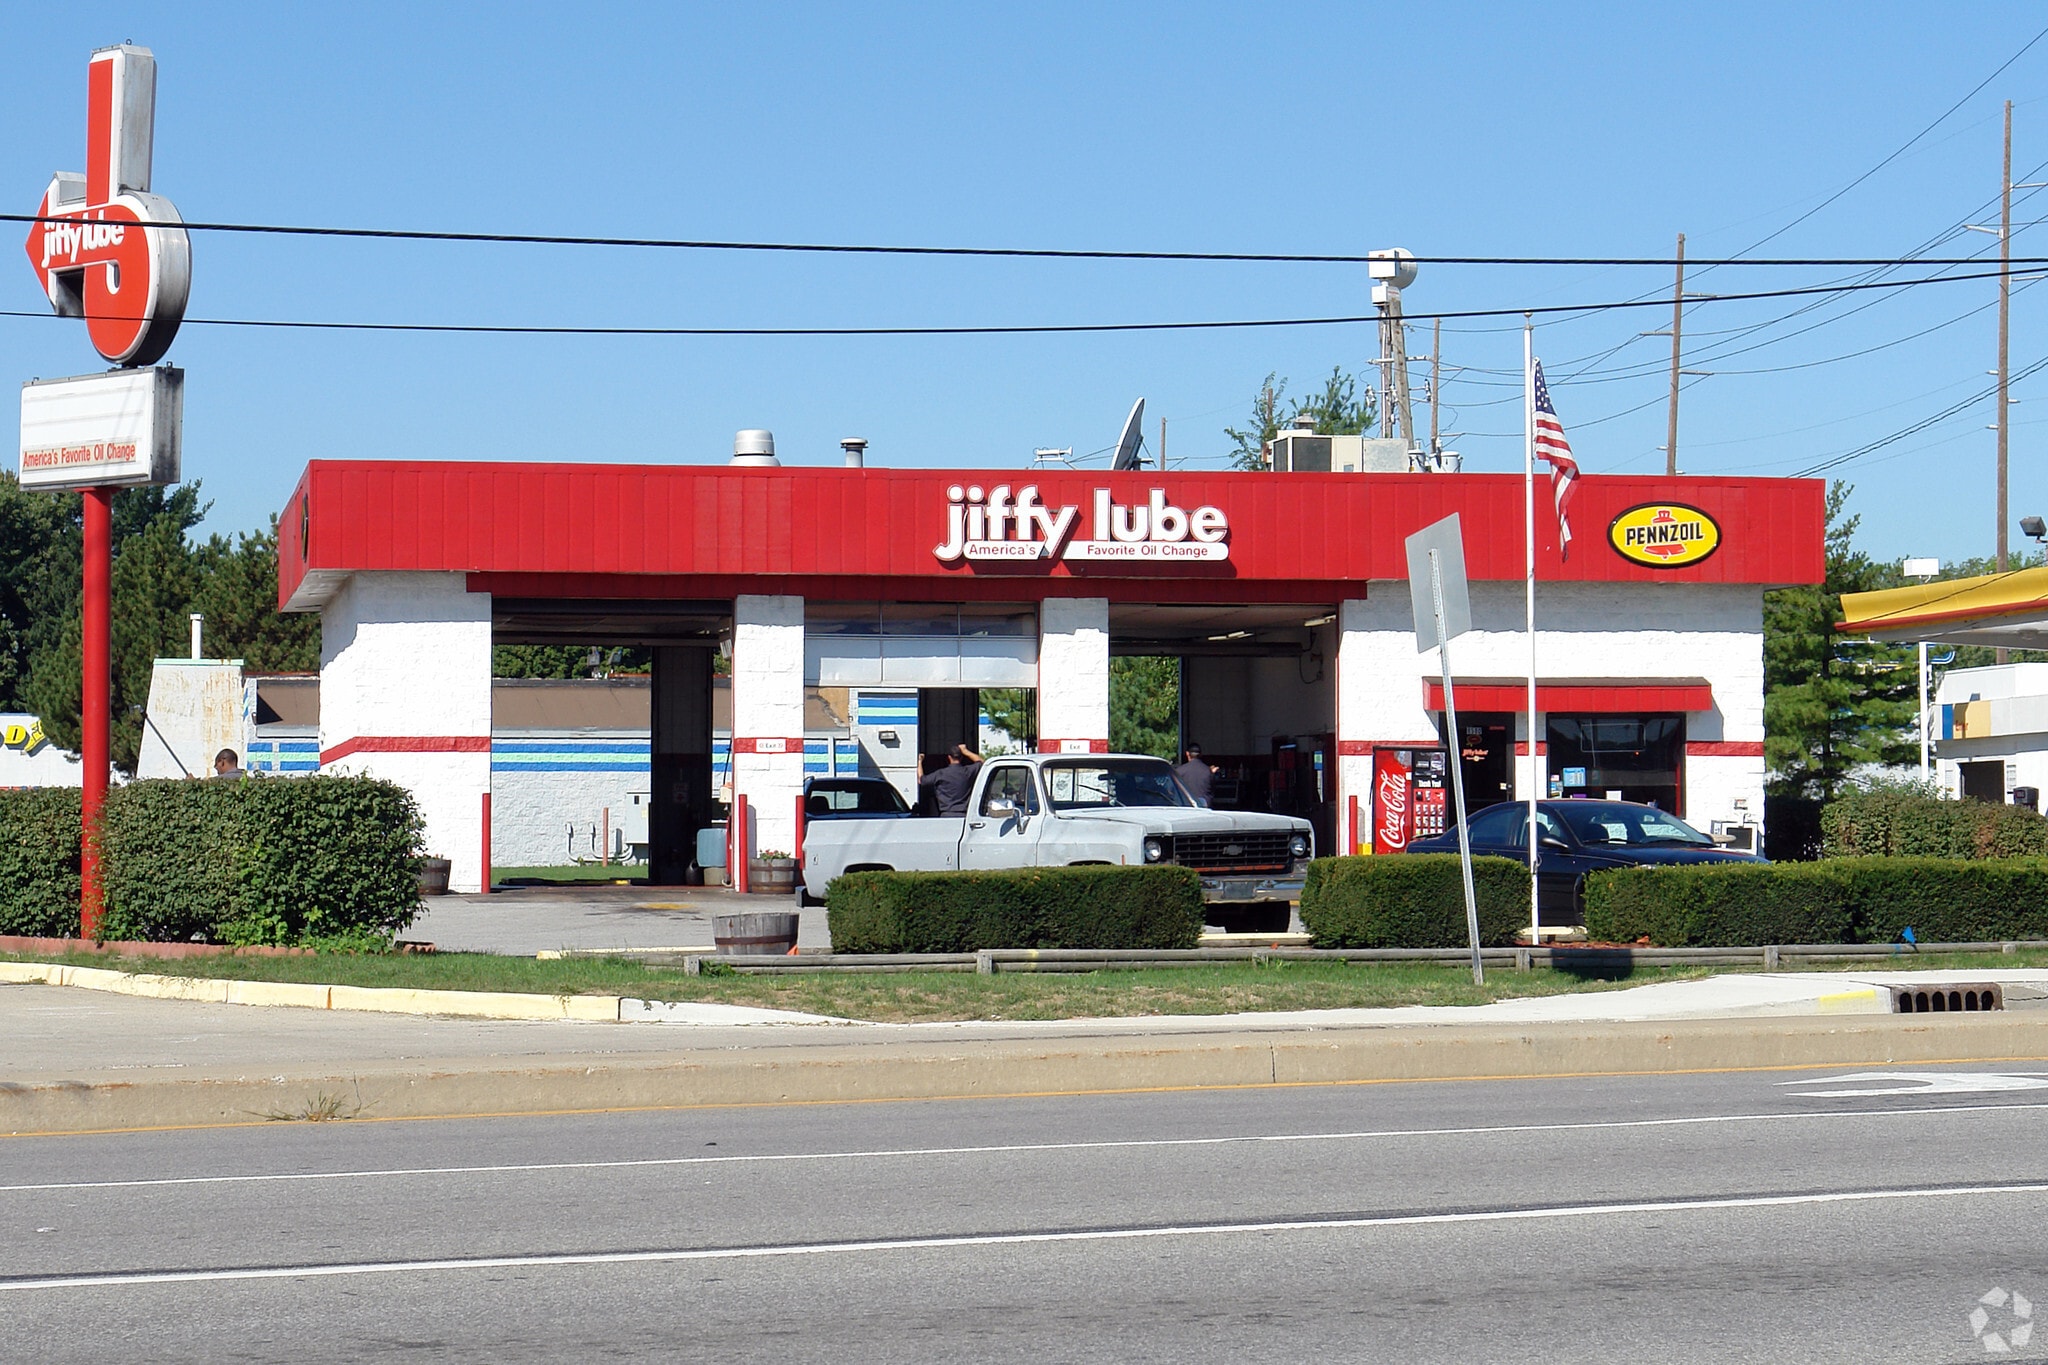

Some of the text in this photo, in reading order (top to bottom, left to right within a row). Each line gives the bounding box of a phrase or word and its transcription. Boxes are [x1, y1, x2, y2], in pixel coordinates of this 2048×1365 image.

[42, 210, 125, 268] jiffy lube
[23, 442, 136, 468] America's Favorite Oil Change
[932, 483, 1229, 561] jiffy lube
[1626, 522, 1704, 546] PENNZOIL
[968, 543, 1208, 558] America's Favorite Oil Change
